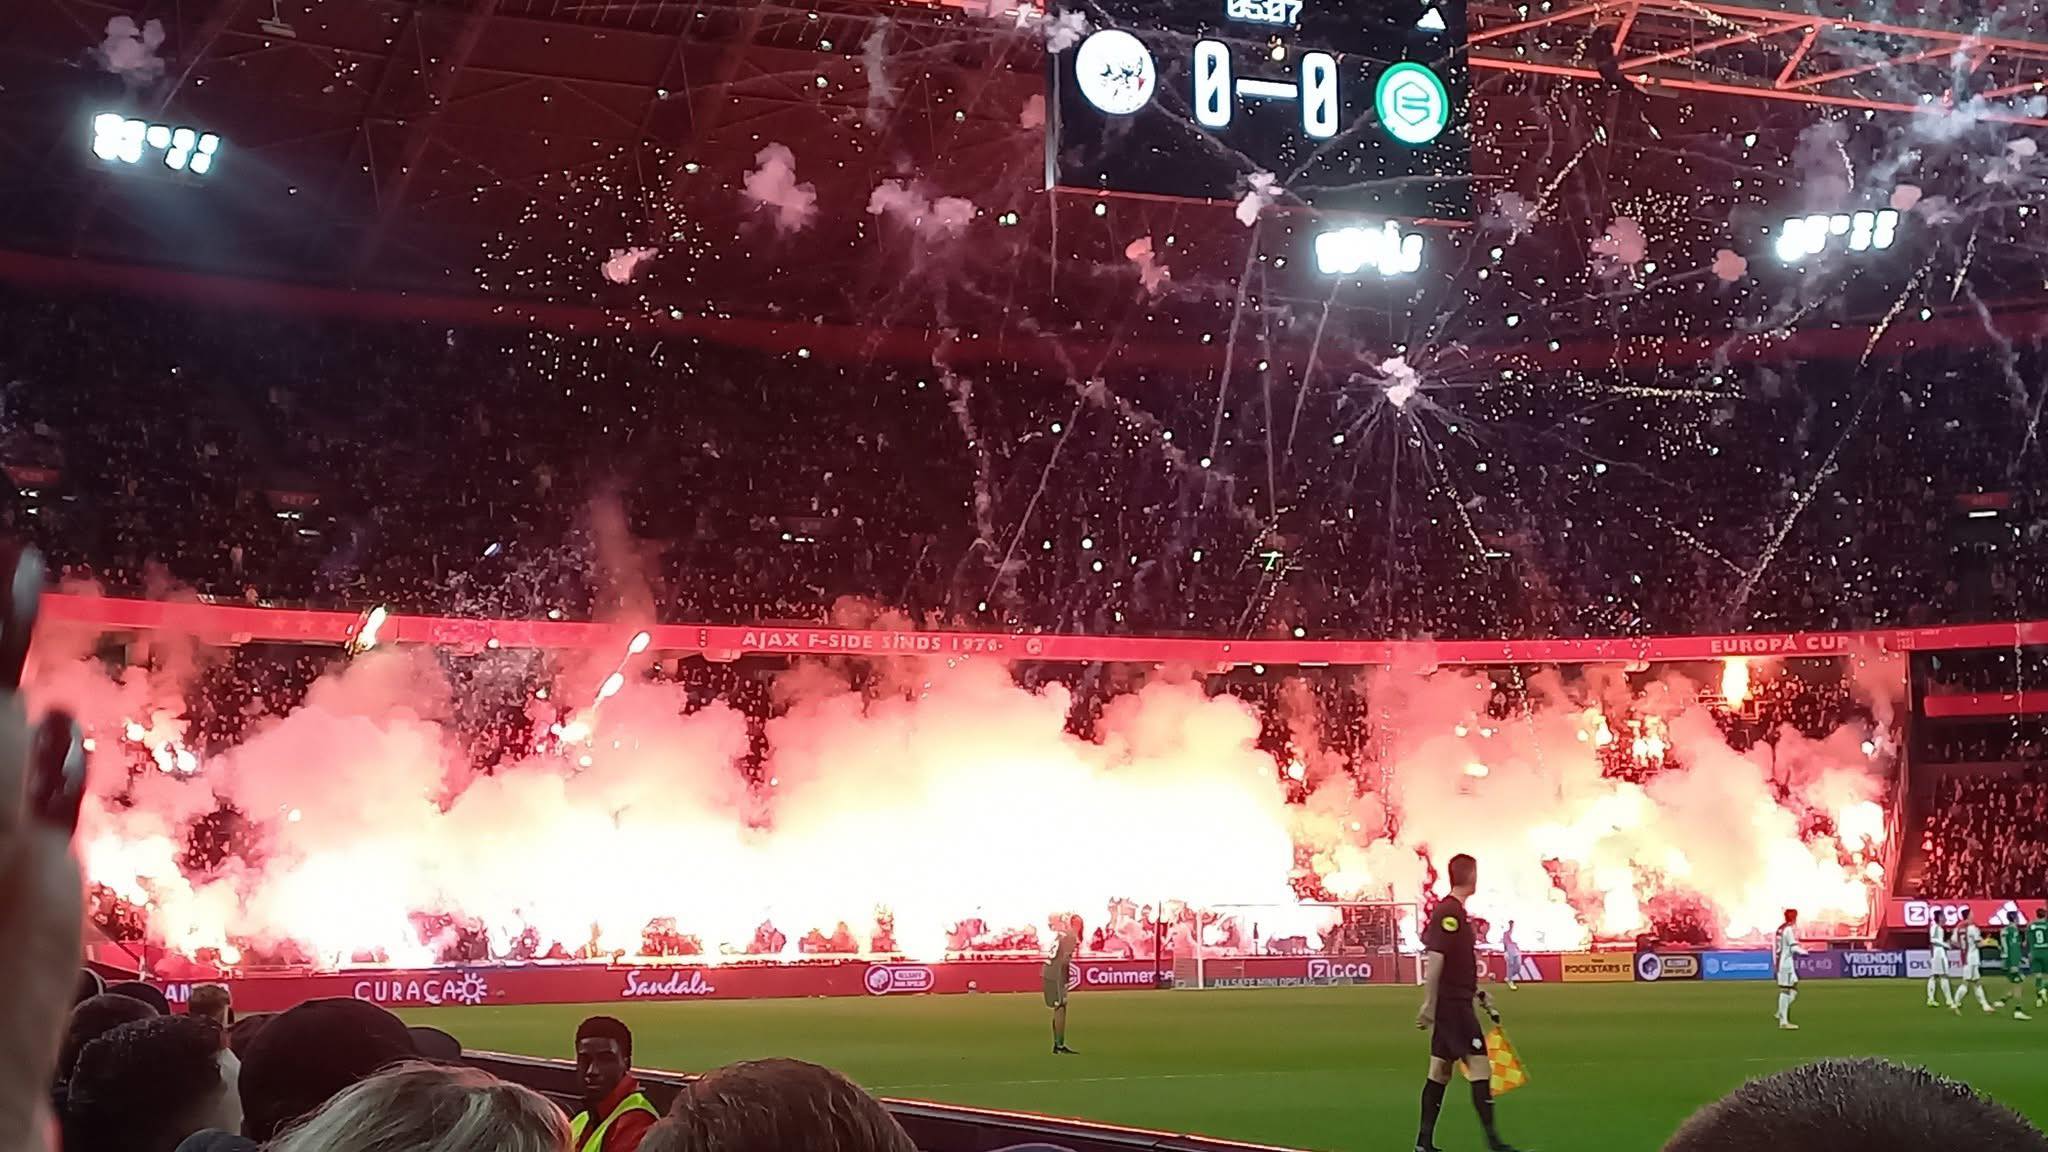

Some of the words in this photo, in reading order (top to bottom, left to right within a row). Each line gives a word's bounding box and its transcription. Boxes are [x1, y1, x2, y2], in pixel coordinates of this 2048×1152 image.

[742, 632, 799, 648] AJAX
[808, 634, 873, 649] F-SIDE
[881, 634, 942, 650] SINDS
[1710, 636, 1798, 653] EUROPA
[1806, 635, 1848, 650] CUP
[1843, 951, 1903, 964] VRIENDEN
[1565, 964, 1620, 973] ROCKSTARS
[622, 969, 716, 997] Sandals
